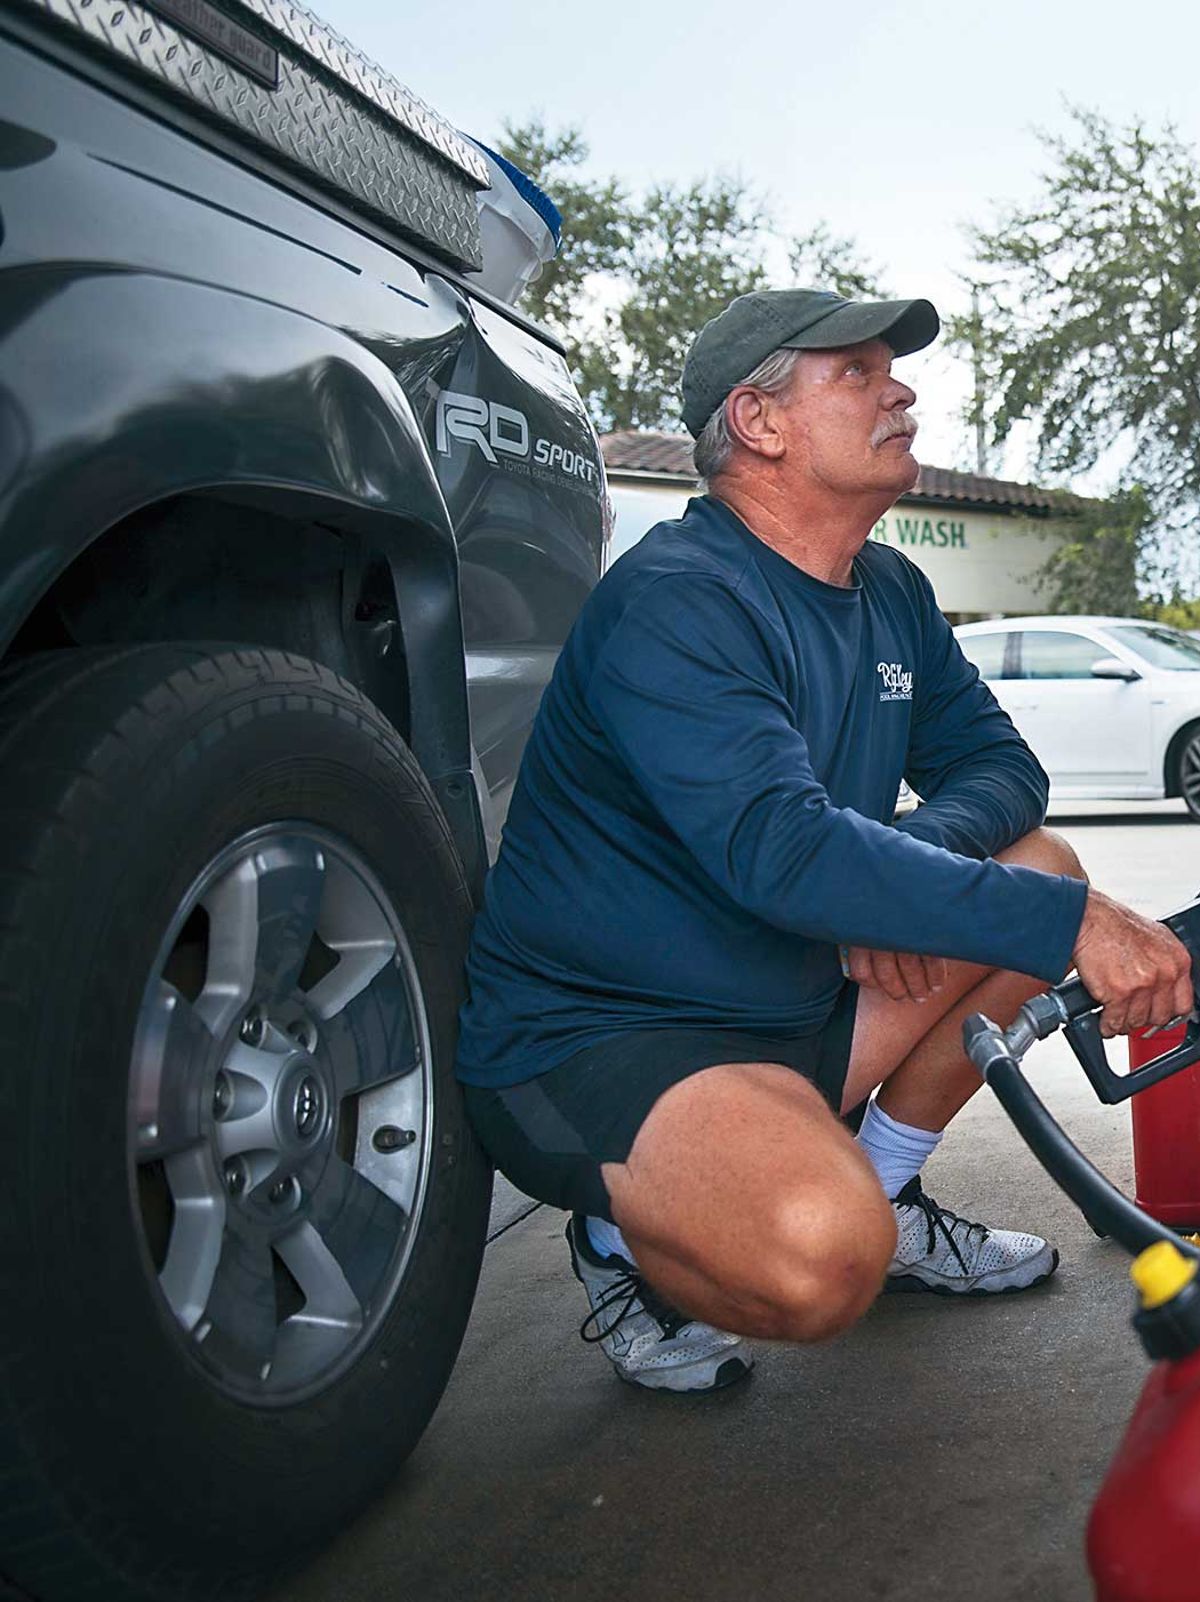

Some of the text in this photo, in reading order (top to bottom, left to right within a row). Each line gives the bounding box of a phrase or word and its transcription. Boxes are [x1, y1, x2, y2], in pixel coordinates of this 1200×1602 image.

[229, 29, 272, 70] guard
[503, 459, 531, 476] TOYOTA
[533, 439, 595, 482] SPORT
[896, 519, 965, 548] WASH
